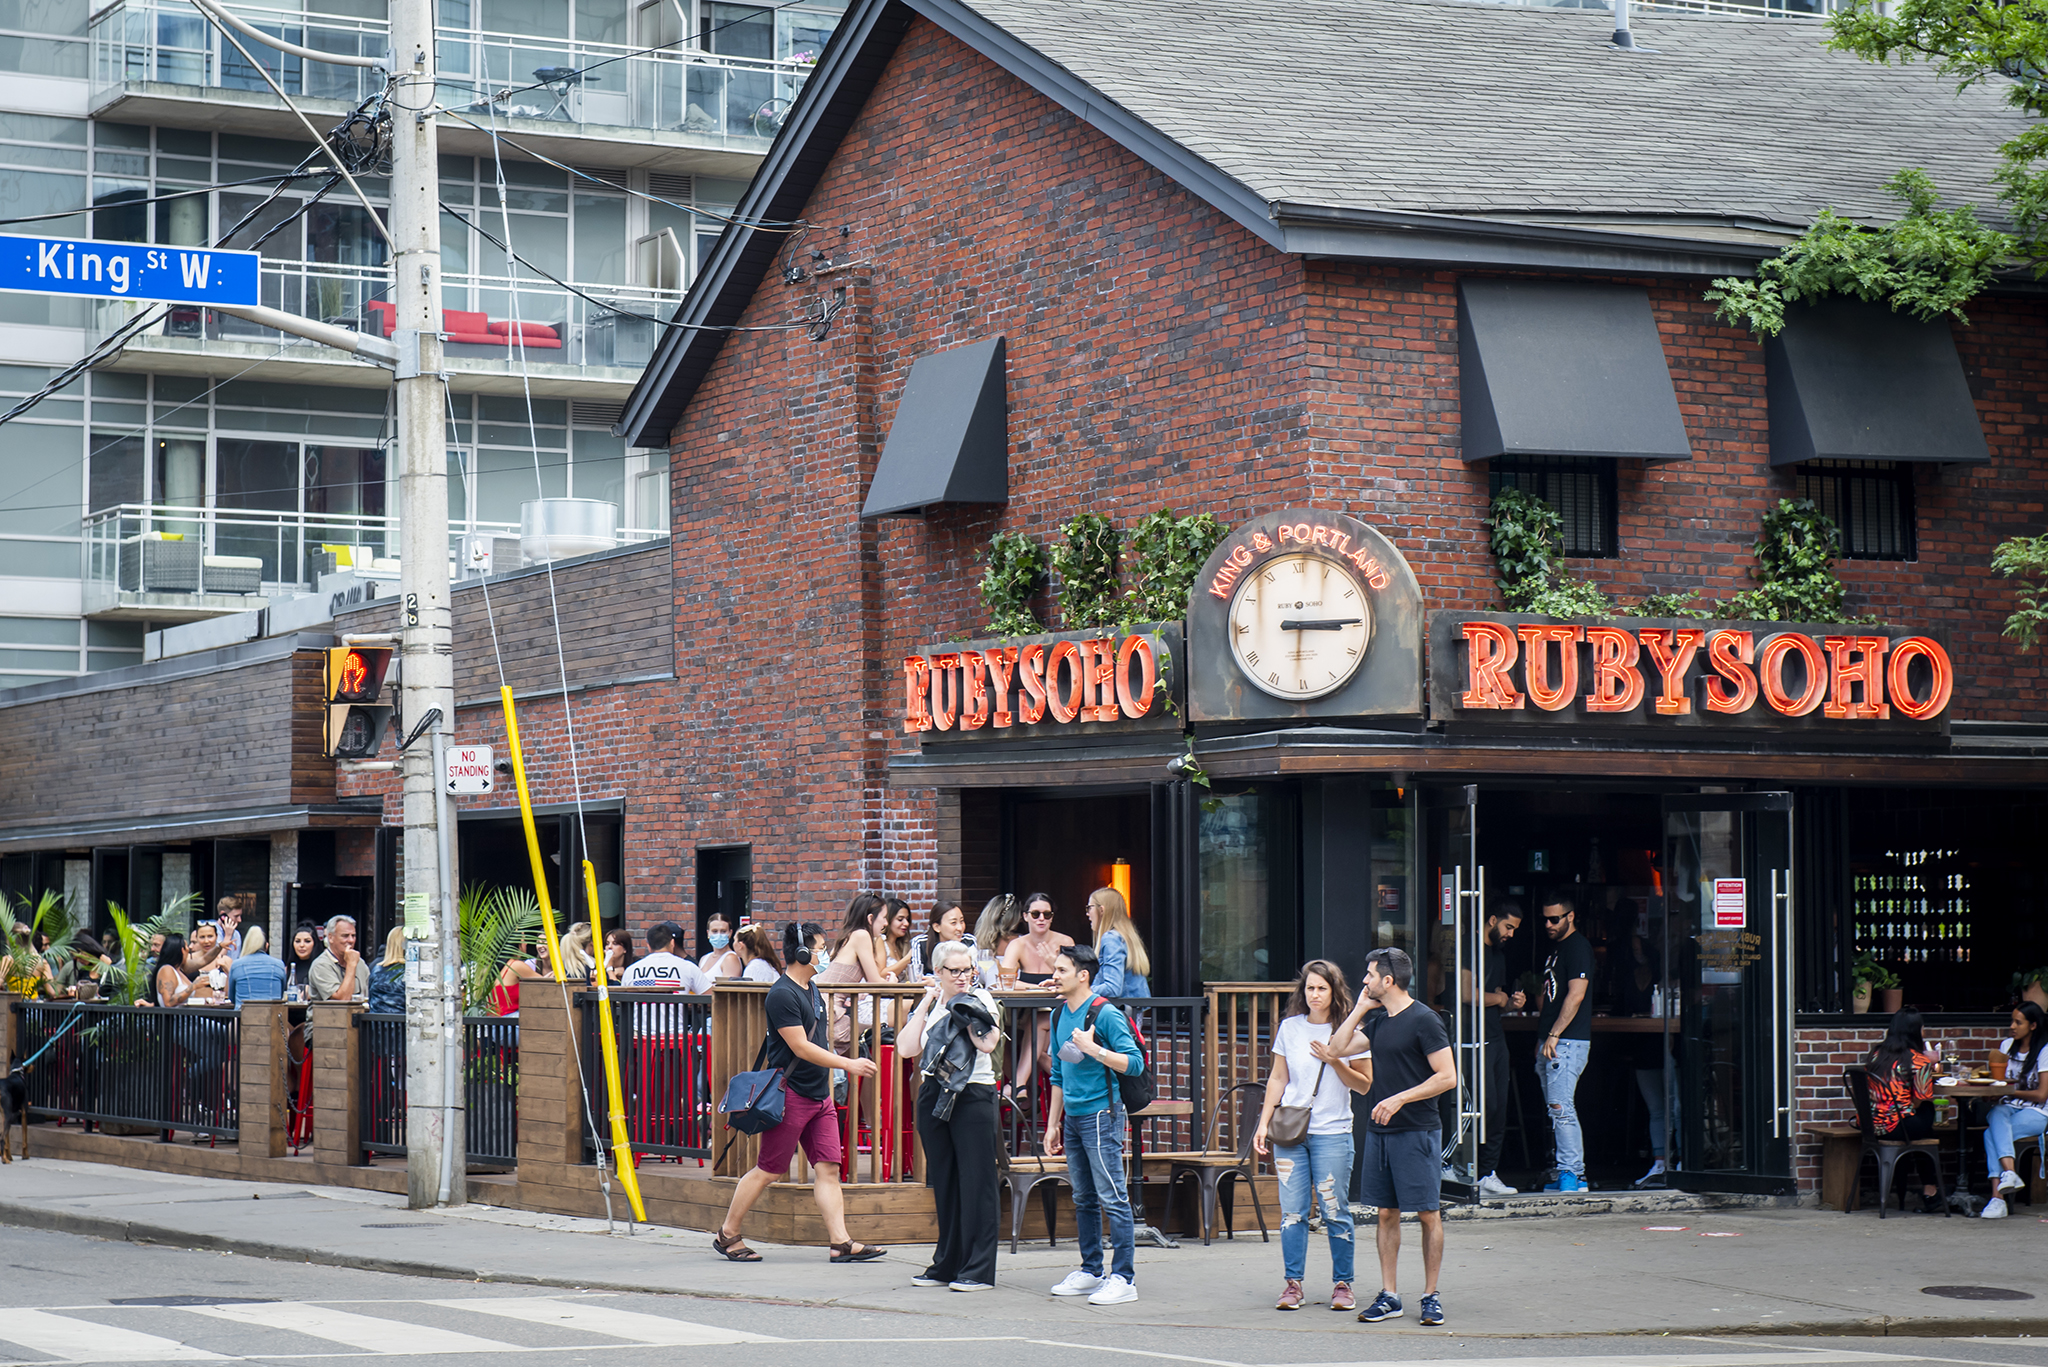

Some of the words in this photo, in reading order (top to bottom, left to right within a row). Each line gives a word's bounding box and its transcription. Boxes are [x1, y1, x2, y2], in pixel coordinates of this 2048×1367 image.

[38, 242, 130, 294] King
[147, 250, 168, 270] St
[180, 252, 211, 289] W
[1208, 544, 1253, 600] KING
[1252, 531, 1273, 553] &
[1277, 523, 1391, 591] PORTLAND
[1277, 602, 1292, 610] RUBY
[1305, 600, 1323, 608] SOHO
[903, 633, 1157, 734] RUBYSOHO
[1460, 621, 1954, 721] RUBYSOHO
[448, 765, 490, 777] STANDING
[461, 750, 476, 762] NO
[633, 966, 681, 979] NASA
